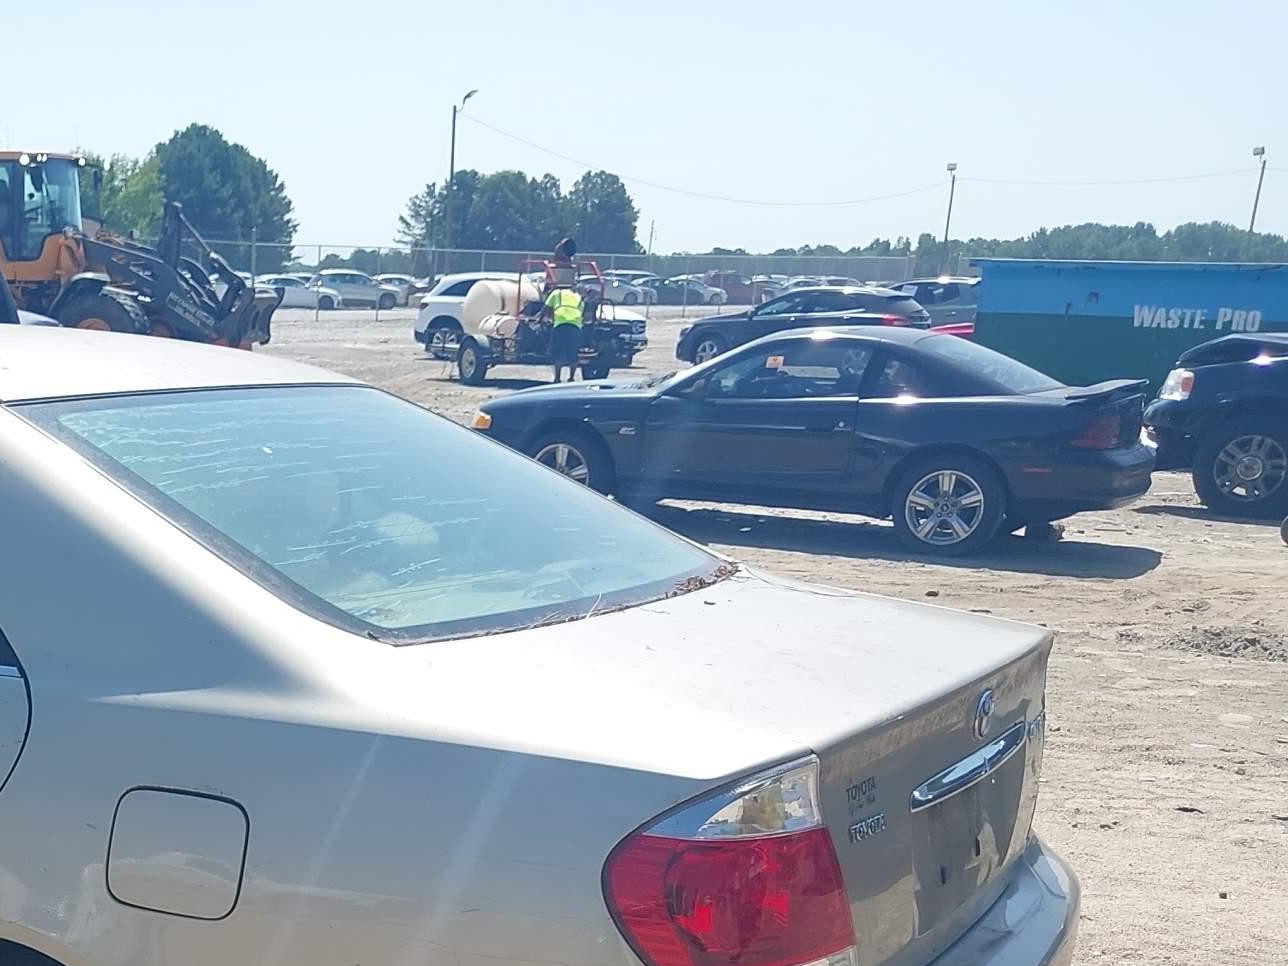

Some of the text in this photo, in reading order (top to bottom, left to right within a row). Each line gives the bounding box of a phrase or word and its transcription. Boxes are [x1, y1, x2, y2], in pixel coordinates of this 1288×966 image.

[1133, 304, 1262, 332] WASTE PRO
[846, 776, 876, 803] TOYOTA
[849, 813, 886, 843] TOYOTA
